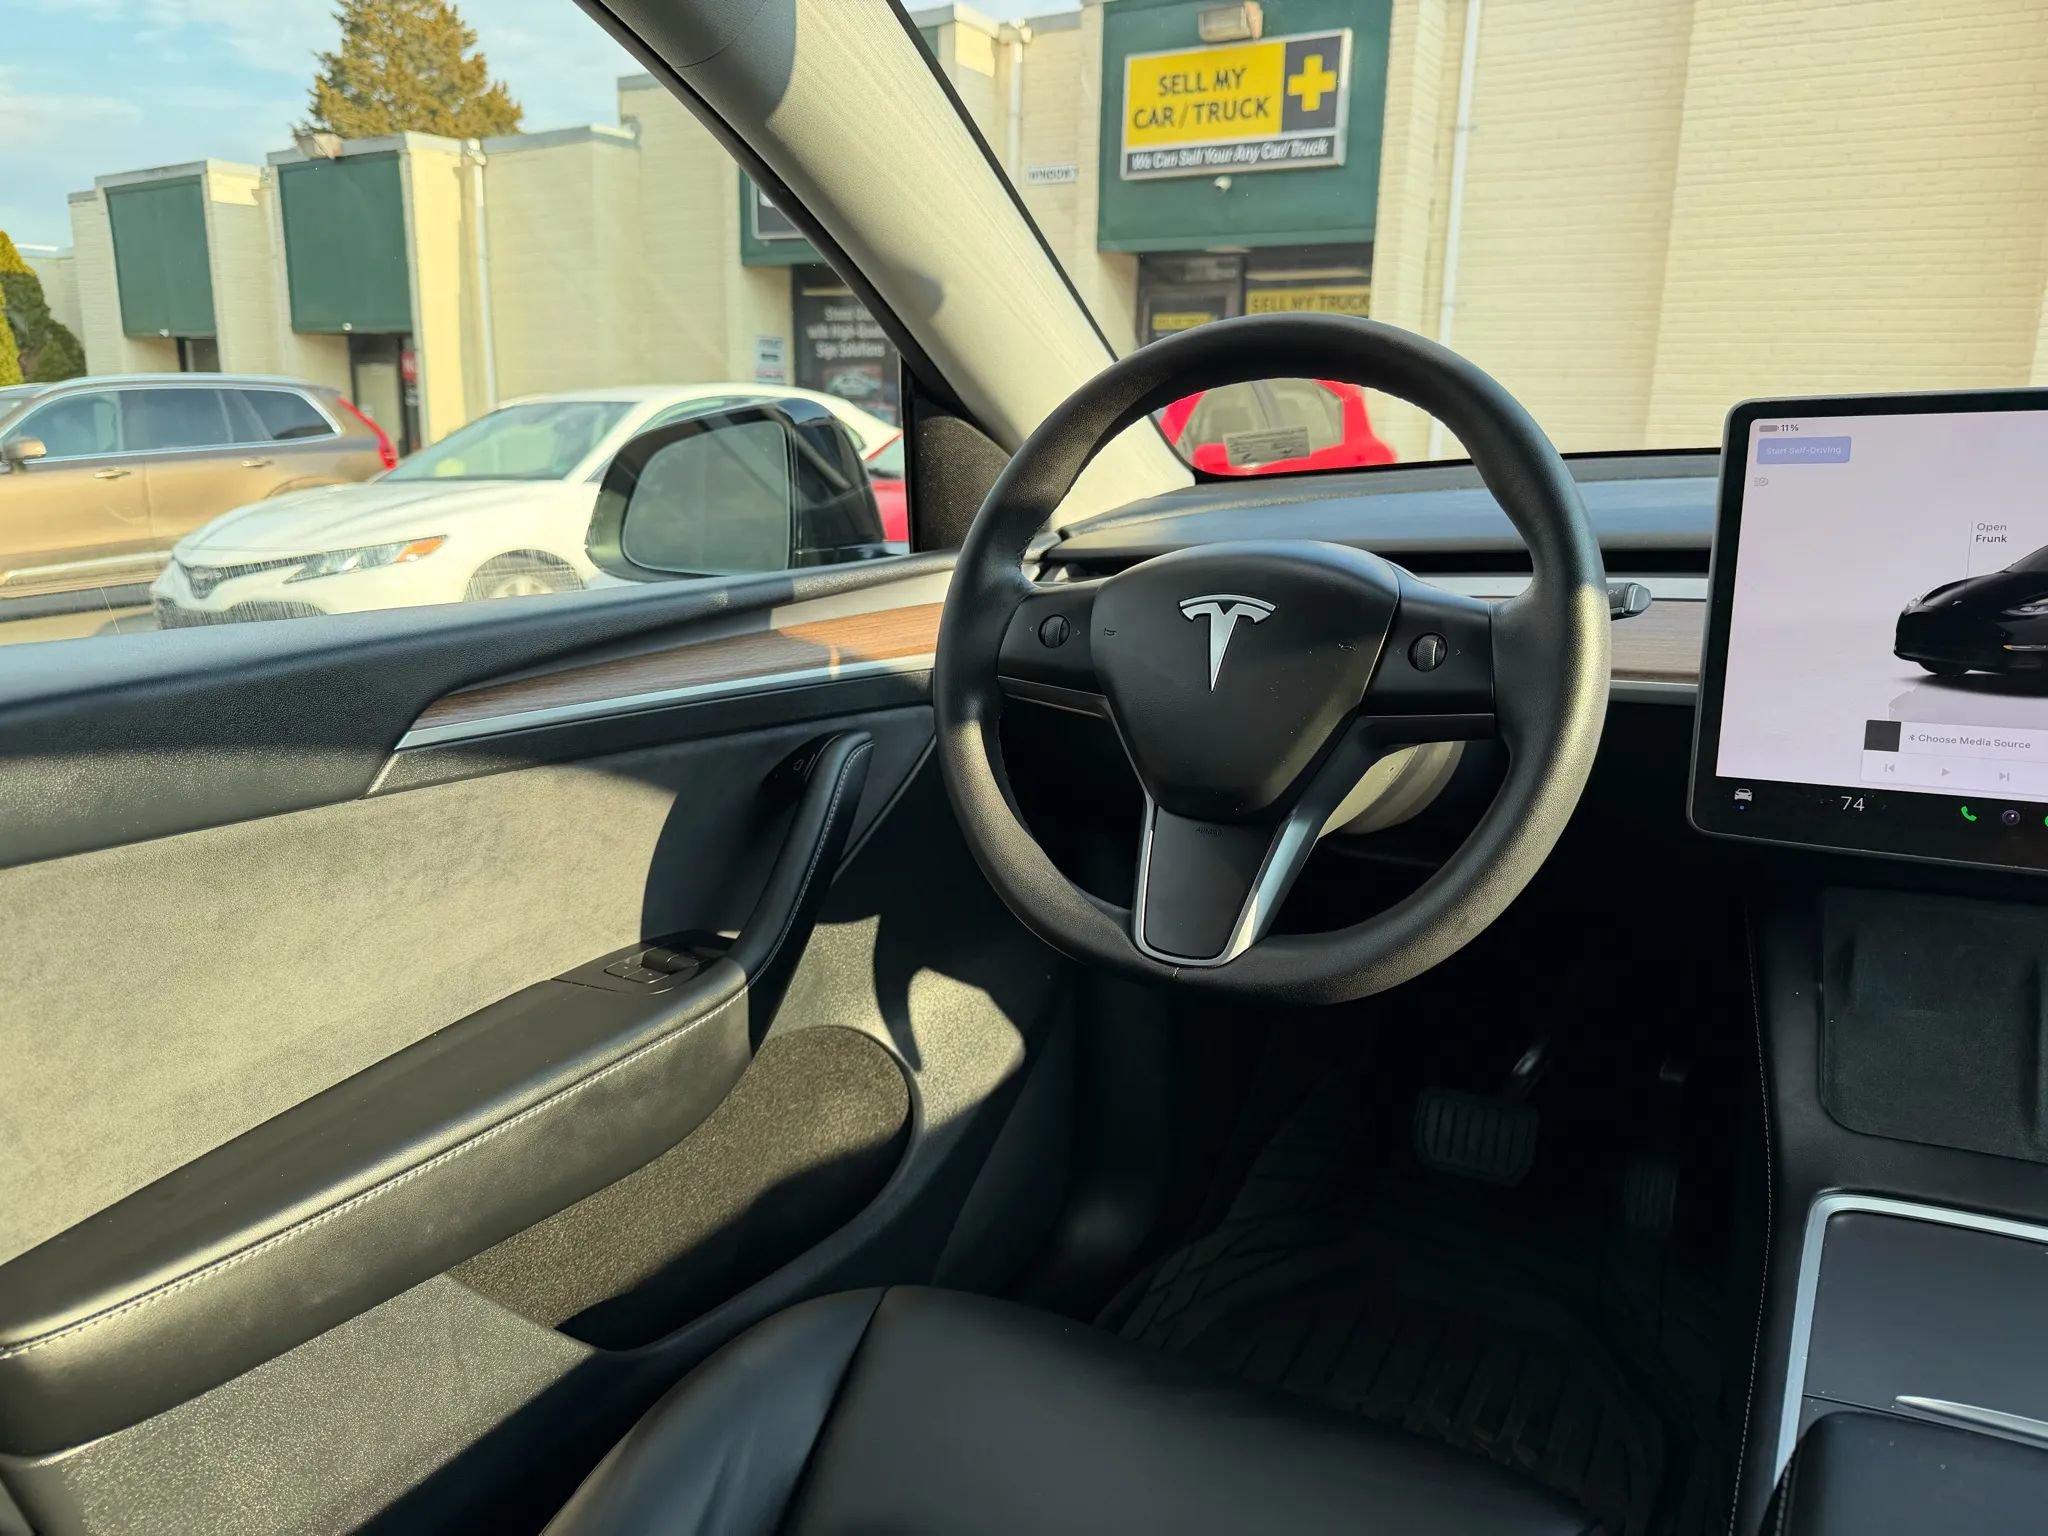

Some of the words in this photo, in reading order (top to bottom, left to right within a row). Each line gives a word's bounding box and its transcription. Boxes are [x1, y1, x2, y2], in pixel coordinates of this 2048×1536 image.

[1158, 72, 1208, 97] SELL
[1214, 67, 1247, 92] MY
[1132, 153, 1151, 170] We
[1152, 151, 1177, 169] Can
[1203, 147, 1232, 165] Your
[1233, 144, 1260, 165] Any
[1766, 447, 1788, 455] Start
[1789, 446, 1842, 456] Self-Driving
[1976, 522, 2007, 533] Open
[1975, 534, 2007, 543] Frunk
[1918, 734, 1957, 744] Choose
[1959, 736, 1991, 747] Media
[1993, 739, 2032, 749] Source
[1839, 795, 1866, 812] 74
